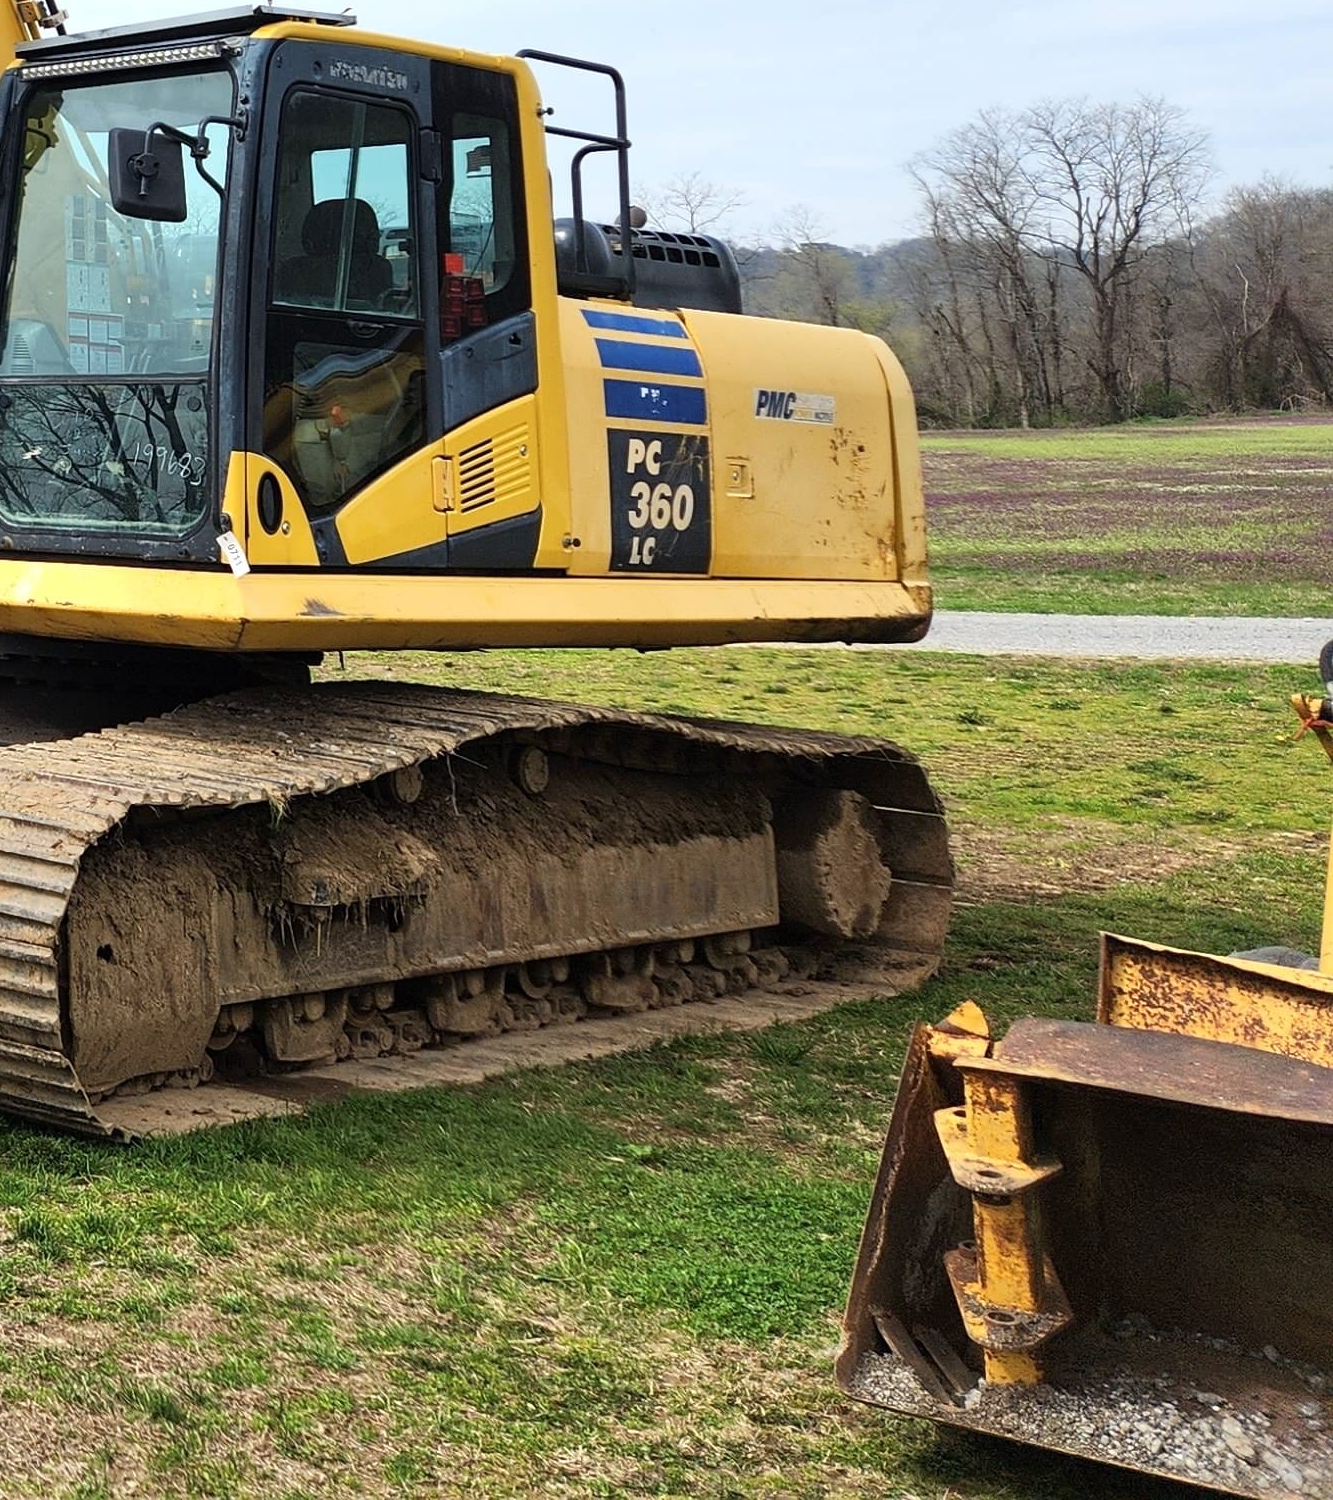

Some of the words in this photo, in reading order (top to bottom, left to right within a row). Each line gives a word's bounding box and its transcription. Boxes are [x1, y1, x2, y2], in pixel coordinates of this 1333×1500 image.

[755, 390, 797, 419] PMC
[133, 442, 206, 487] 199683
[627, 438, 662, 476] PC
[628, 481, 694, 531] 360
[629, 536, 656, 565] LC
